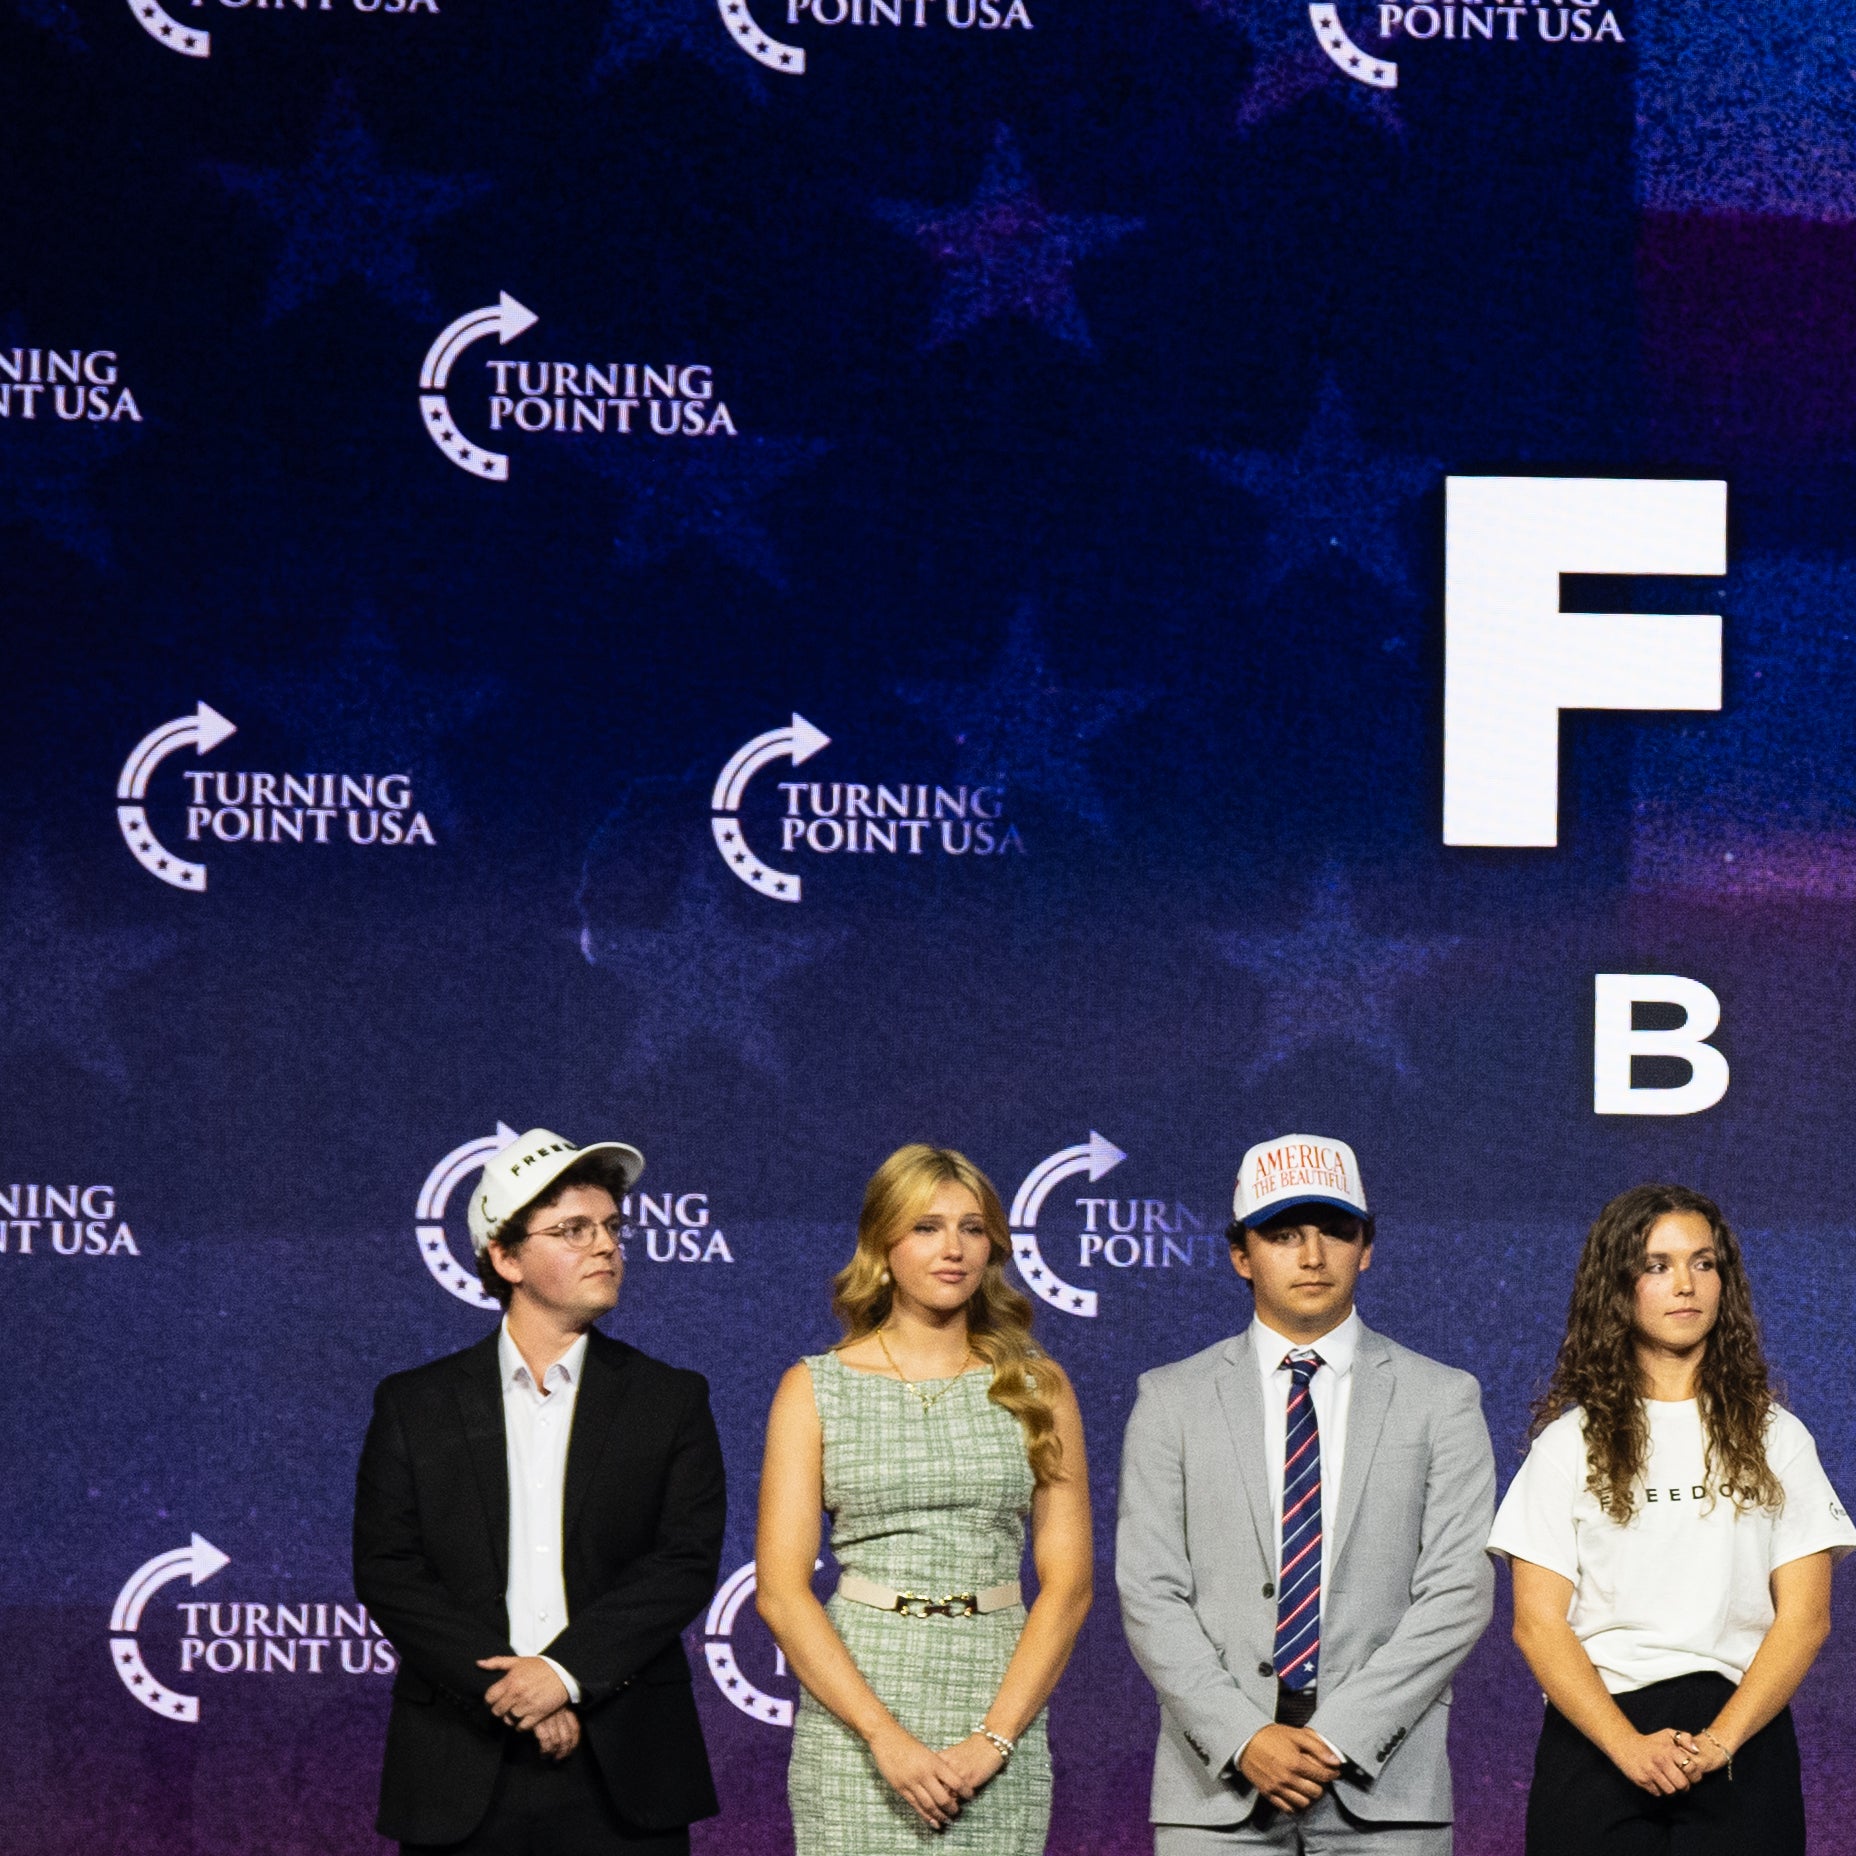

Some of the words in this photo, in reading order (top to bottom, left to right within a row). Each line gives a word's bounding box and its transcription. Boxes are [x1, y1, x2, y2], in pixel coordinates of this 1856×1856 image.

[946, 0, 1034, 29] USA
[1375, 4, 1527, 40] POINT
[1536, 7, 1625, 42] USA
[486, 361, 712, 400] TURNING
[53, 385, 143, 422] USA
[489, 396, 640, 433] POINT
[649, 400, 738, 436] USA
[184, 771, 411, 809] TURNING
[777, 782, 1005, 819] TURNING
[186, 806, 337, 842] POINT
[347, 809, 436, 845] USA
[781, 817, 931, 854] POINT
[940, 820, 1027, 855] USA
[1255, 1144, 1345, 1181] AMERICA
[1252, 1176, 1278, 1199] THE
[1280, 1169, 1350, 1194] BEAUTIFUL
[51, 1220, 141, 1256] USA
[645, 1229, 735, 1263] USA
[177, 1602, 384, 1638] TURNIN
[180, 1637, 331, 1673] POINT
[340, 1638, 399, 1675] US
